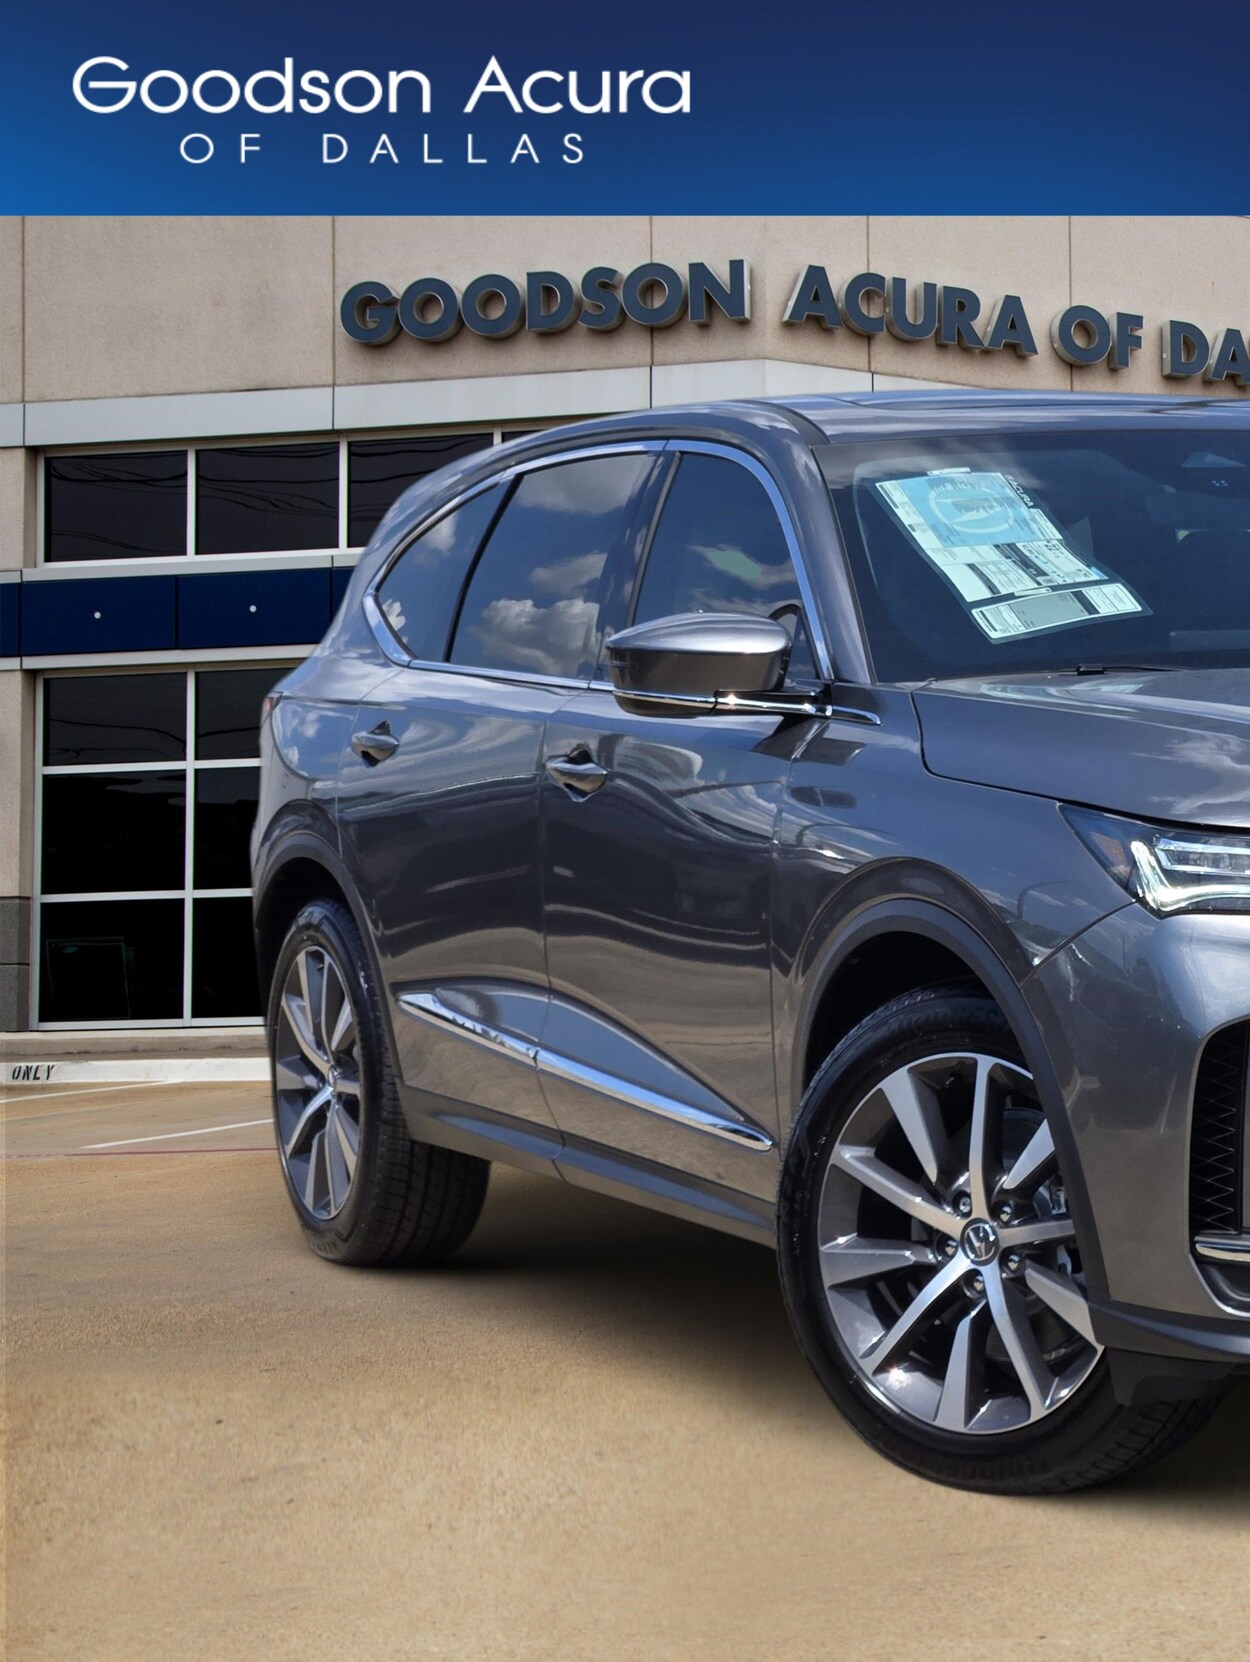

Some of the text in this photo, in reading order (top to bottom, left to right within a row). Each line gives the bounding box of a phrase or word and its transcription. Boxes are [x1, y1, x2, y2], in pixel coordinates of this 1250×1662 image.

[340, 259, 750, 345] GOODSON
[782, 265, 1038, 356] ACURA
[1051, 305, 1144, 369] OF
[12, 1065, 55, 1080] ONLY
